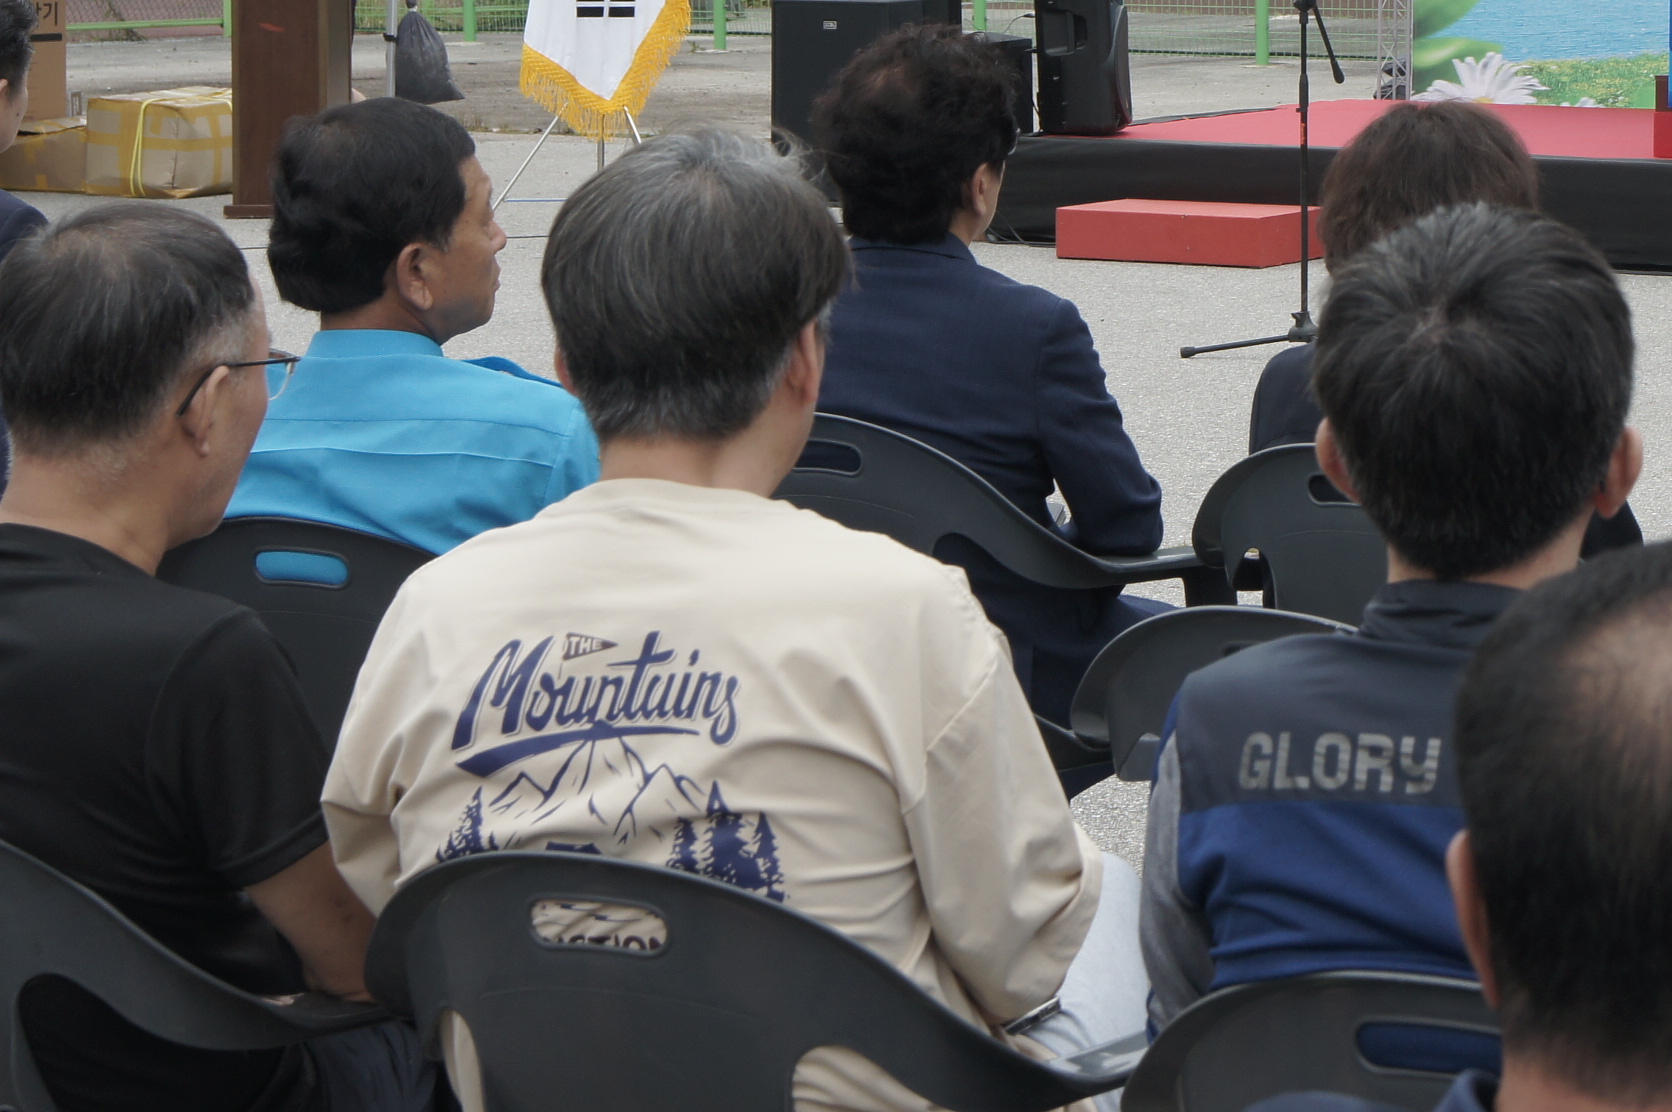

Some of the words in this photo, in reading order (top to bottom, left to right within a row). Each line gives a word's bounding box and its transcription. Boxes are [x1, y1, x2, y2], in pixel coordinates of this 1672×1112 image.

[36, 0, 58, 27] 기
[567, 634, 604, 656] THE
[450, 630, 741, 750] Mountains
[1239, 730, 1443, 796] GLORY
